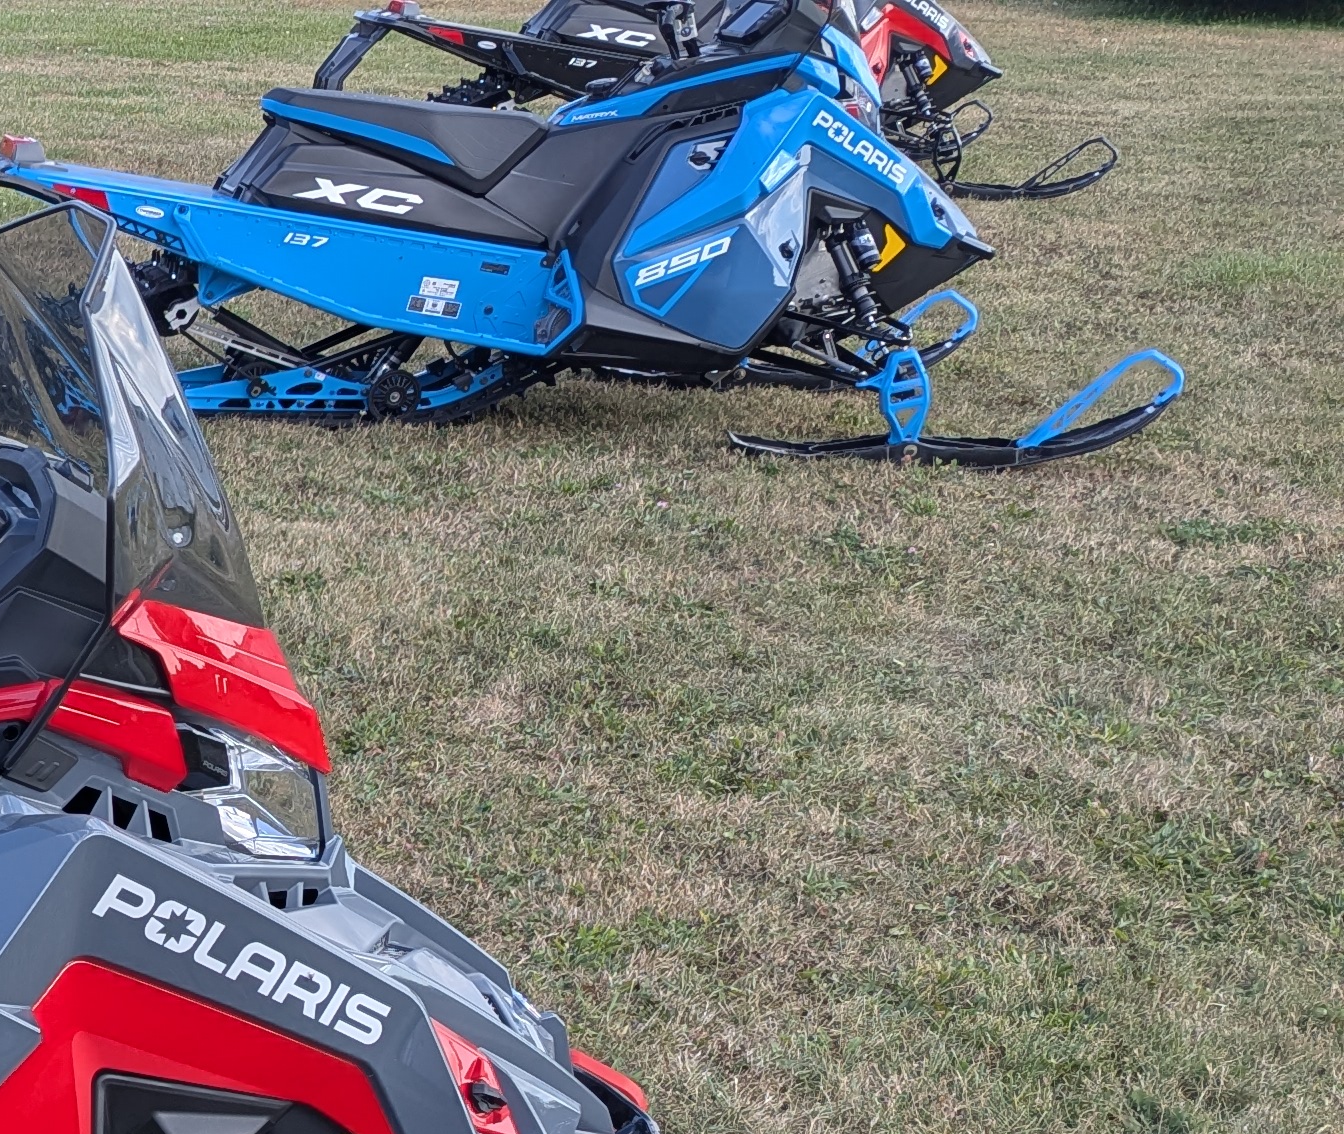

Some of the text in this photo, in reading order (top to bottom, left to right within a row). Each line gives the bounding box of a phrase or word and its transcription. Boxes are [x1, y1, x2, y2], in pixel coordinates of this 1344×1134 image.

[904, 0, 950, 29] LARIS
[576, 24, 657, 47] XC
[569, 57, 598, 68] 137
[570, 109, 619, 123] MATRYX
[812, 109, 908, 185] POLARIS
[292, 177, 424, 215] XC
[283, 232, 330, 248] 137
[634, 236, 732, 287] 850
[202, 760, 229, 777] POLARIS
[92, 873, 391, 1045] POLARIS
